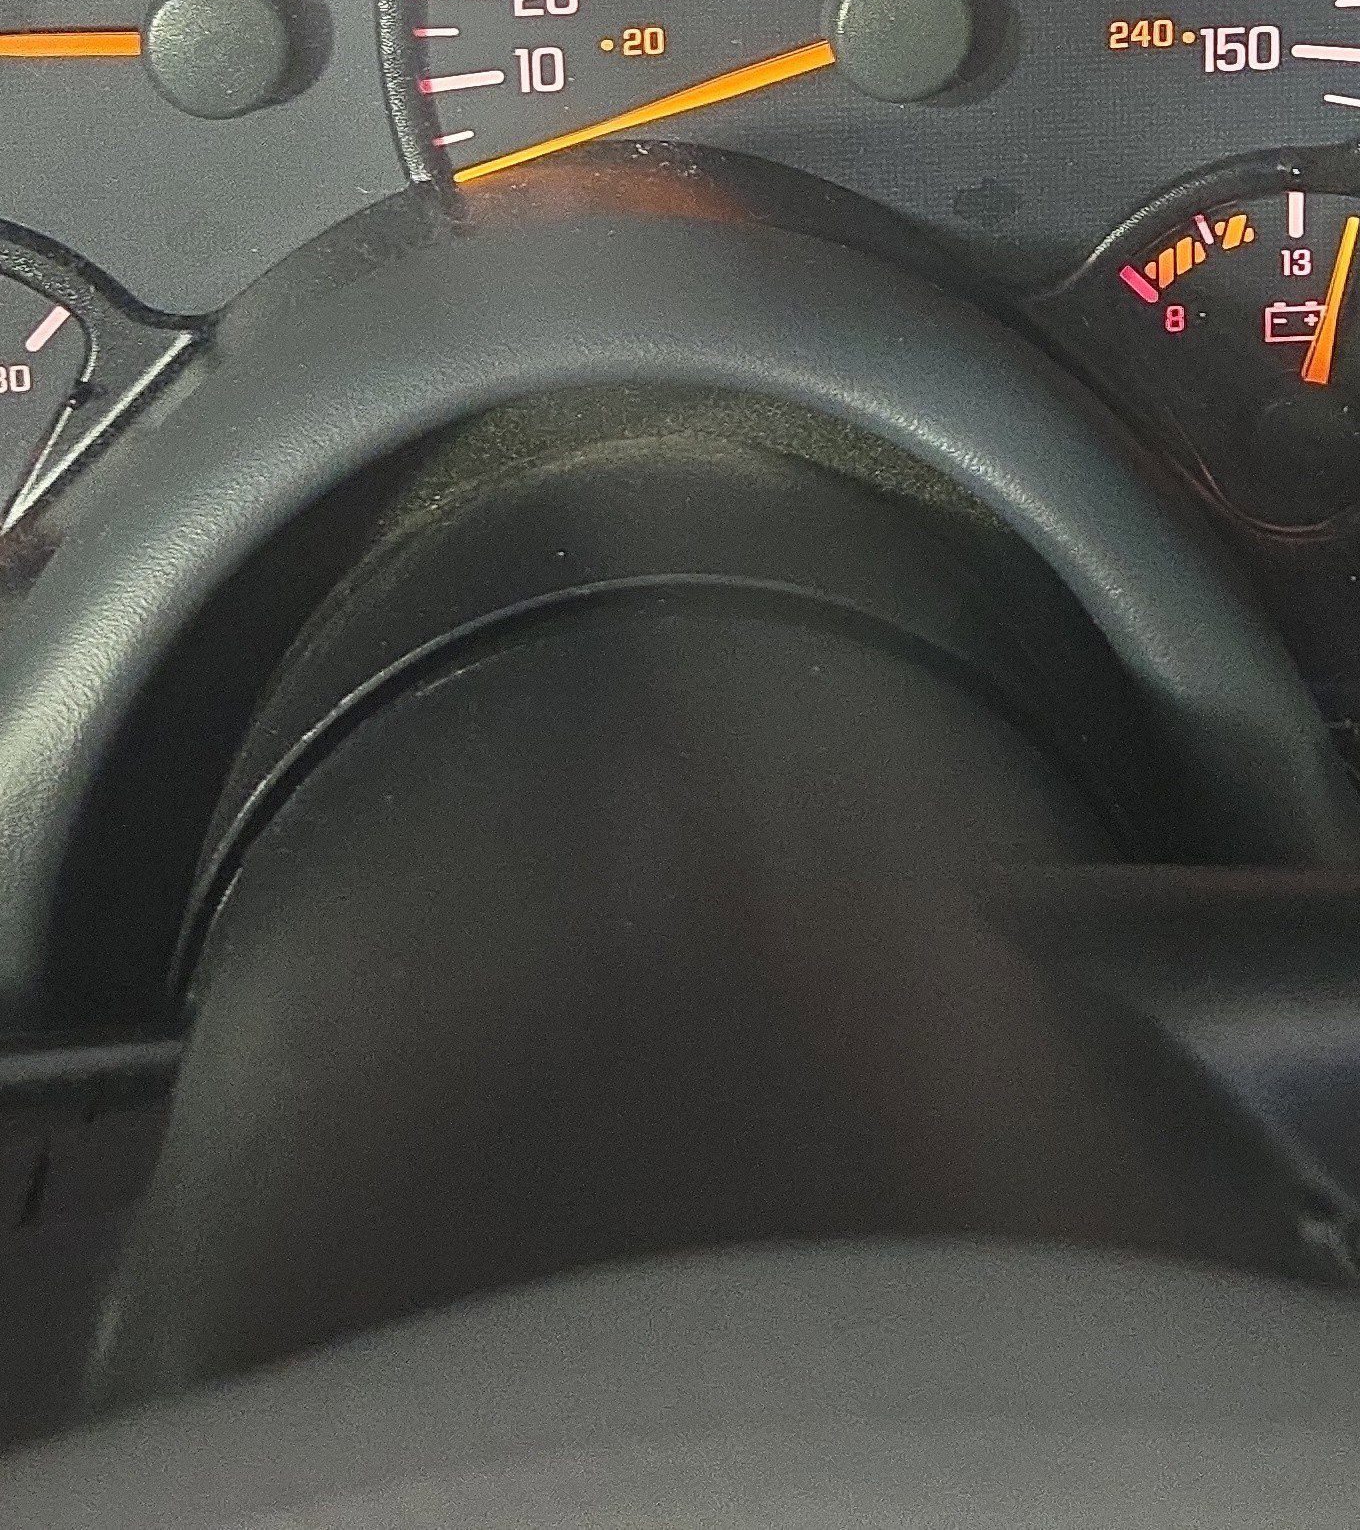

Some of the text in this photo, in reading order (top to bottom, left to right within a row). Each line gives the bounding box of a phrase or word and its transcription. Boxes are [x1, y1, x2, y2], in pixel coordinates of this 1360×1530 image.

[623, 28, 664, 55] 20
[1110, 20, 1173, 48] 240
[1200, 26, 1279, 72] 150
[515, 47, 563, 92] 10
[1282, 250, 1311, 275] 13
[1165, 306, 1185, 333] 8
